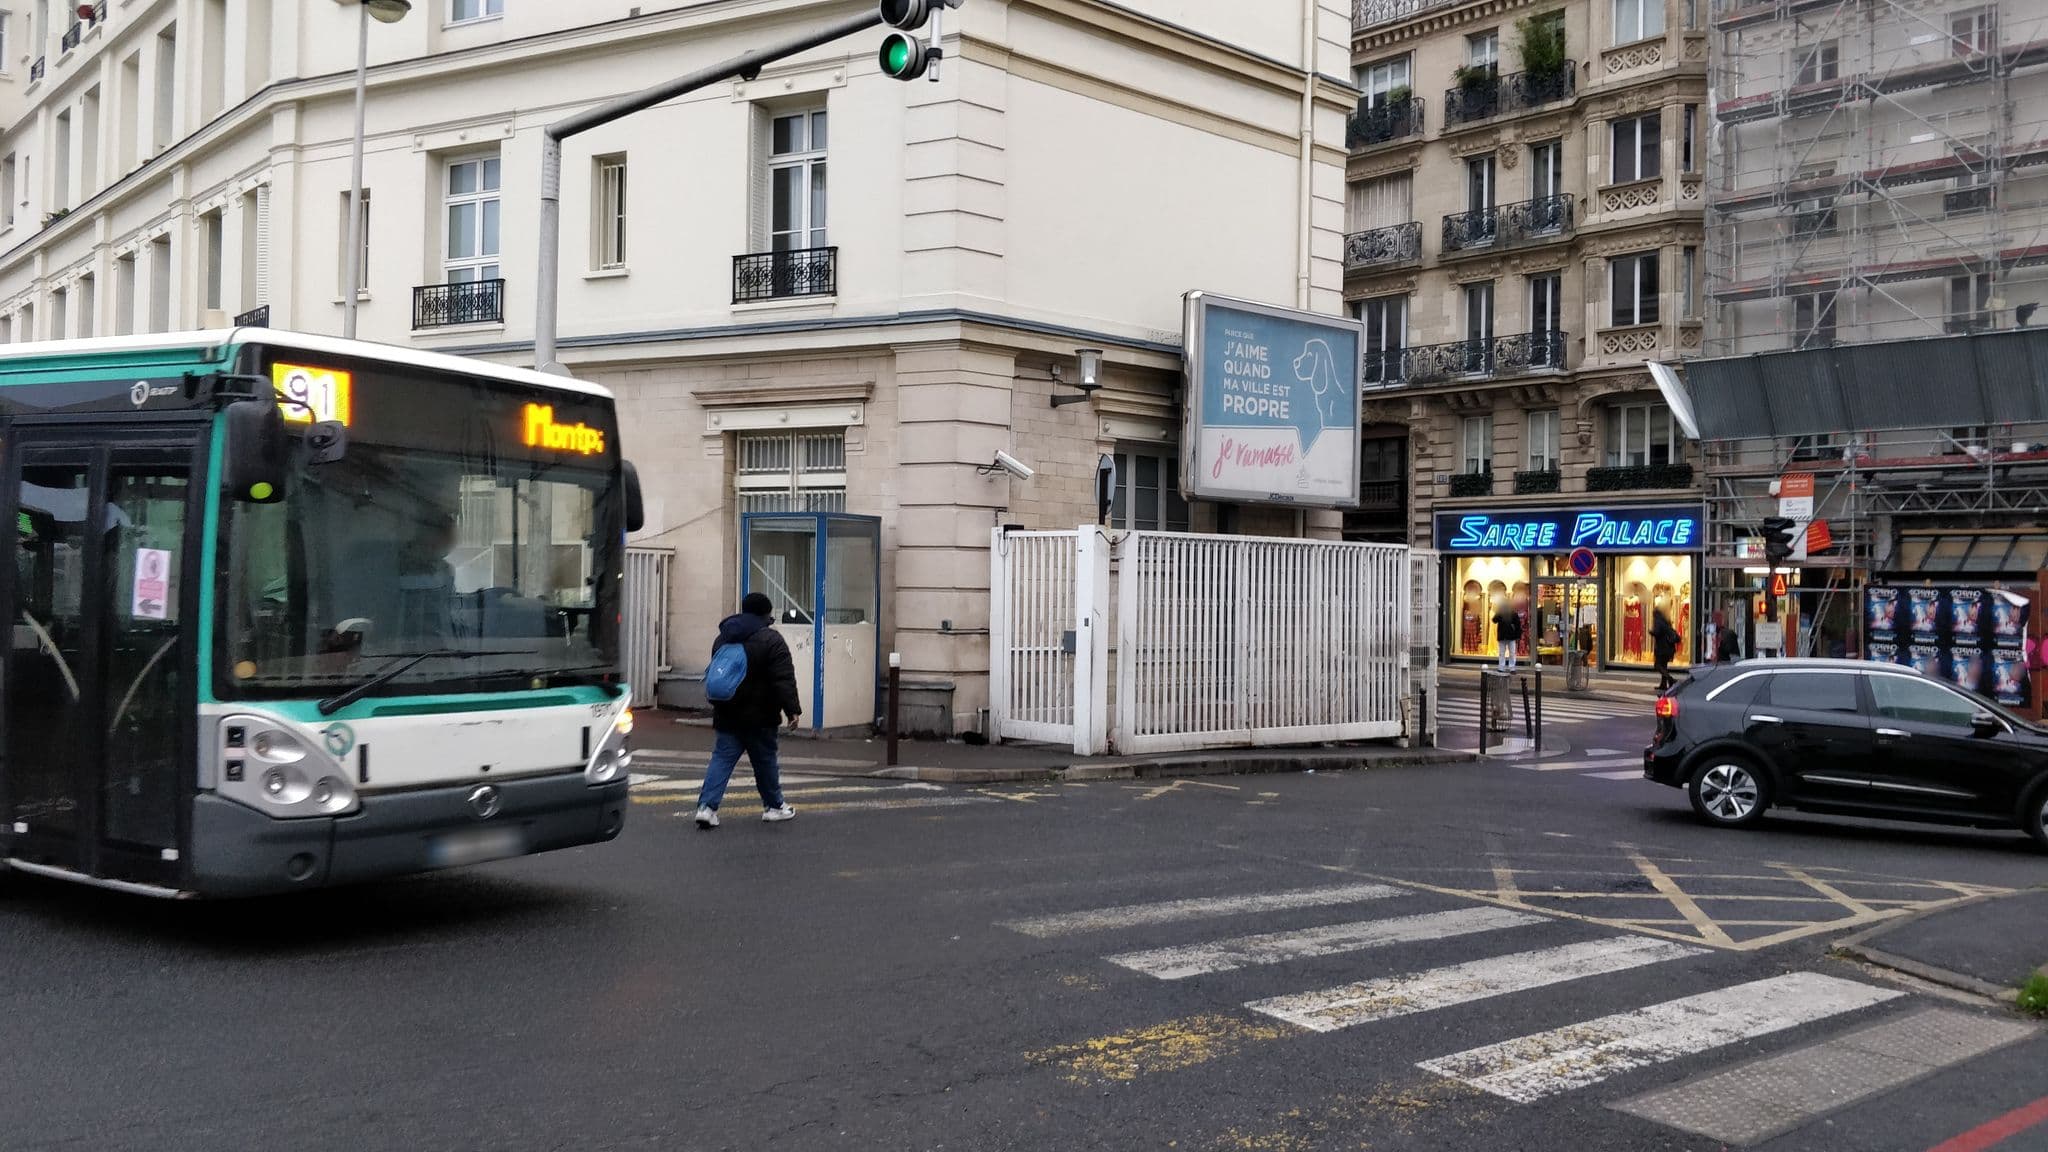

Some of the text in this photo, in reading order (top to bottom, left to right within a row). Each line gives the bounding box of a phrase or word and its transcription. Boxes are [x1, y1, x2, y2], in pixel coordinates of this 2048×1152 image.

[1224, 341, 1268, 361] J'AIME
[1224, 360, 1271, 379] QUAND
[288, 373, 330, 416] 91
[1223, 378, 1290, 397] MA VILLE EST
[1223, 393, 1290, 419] PROPRE
[1213, 434, 1294, 479] je ramasse
